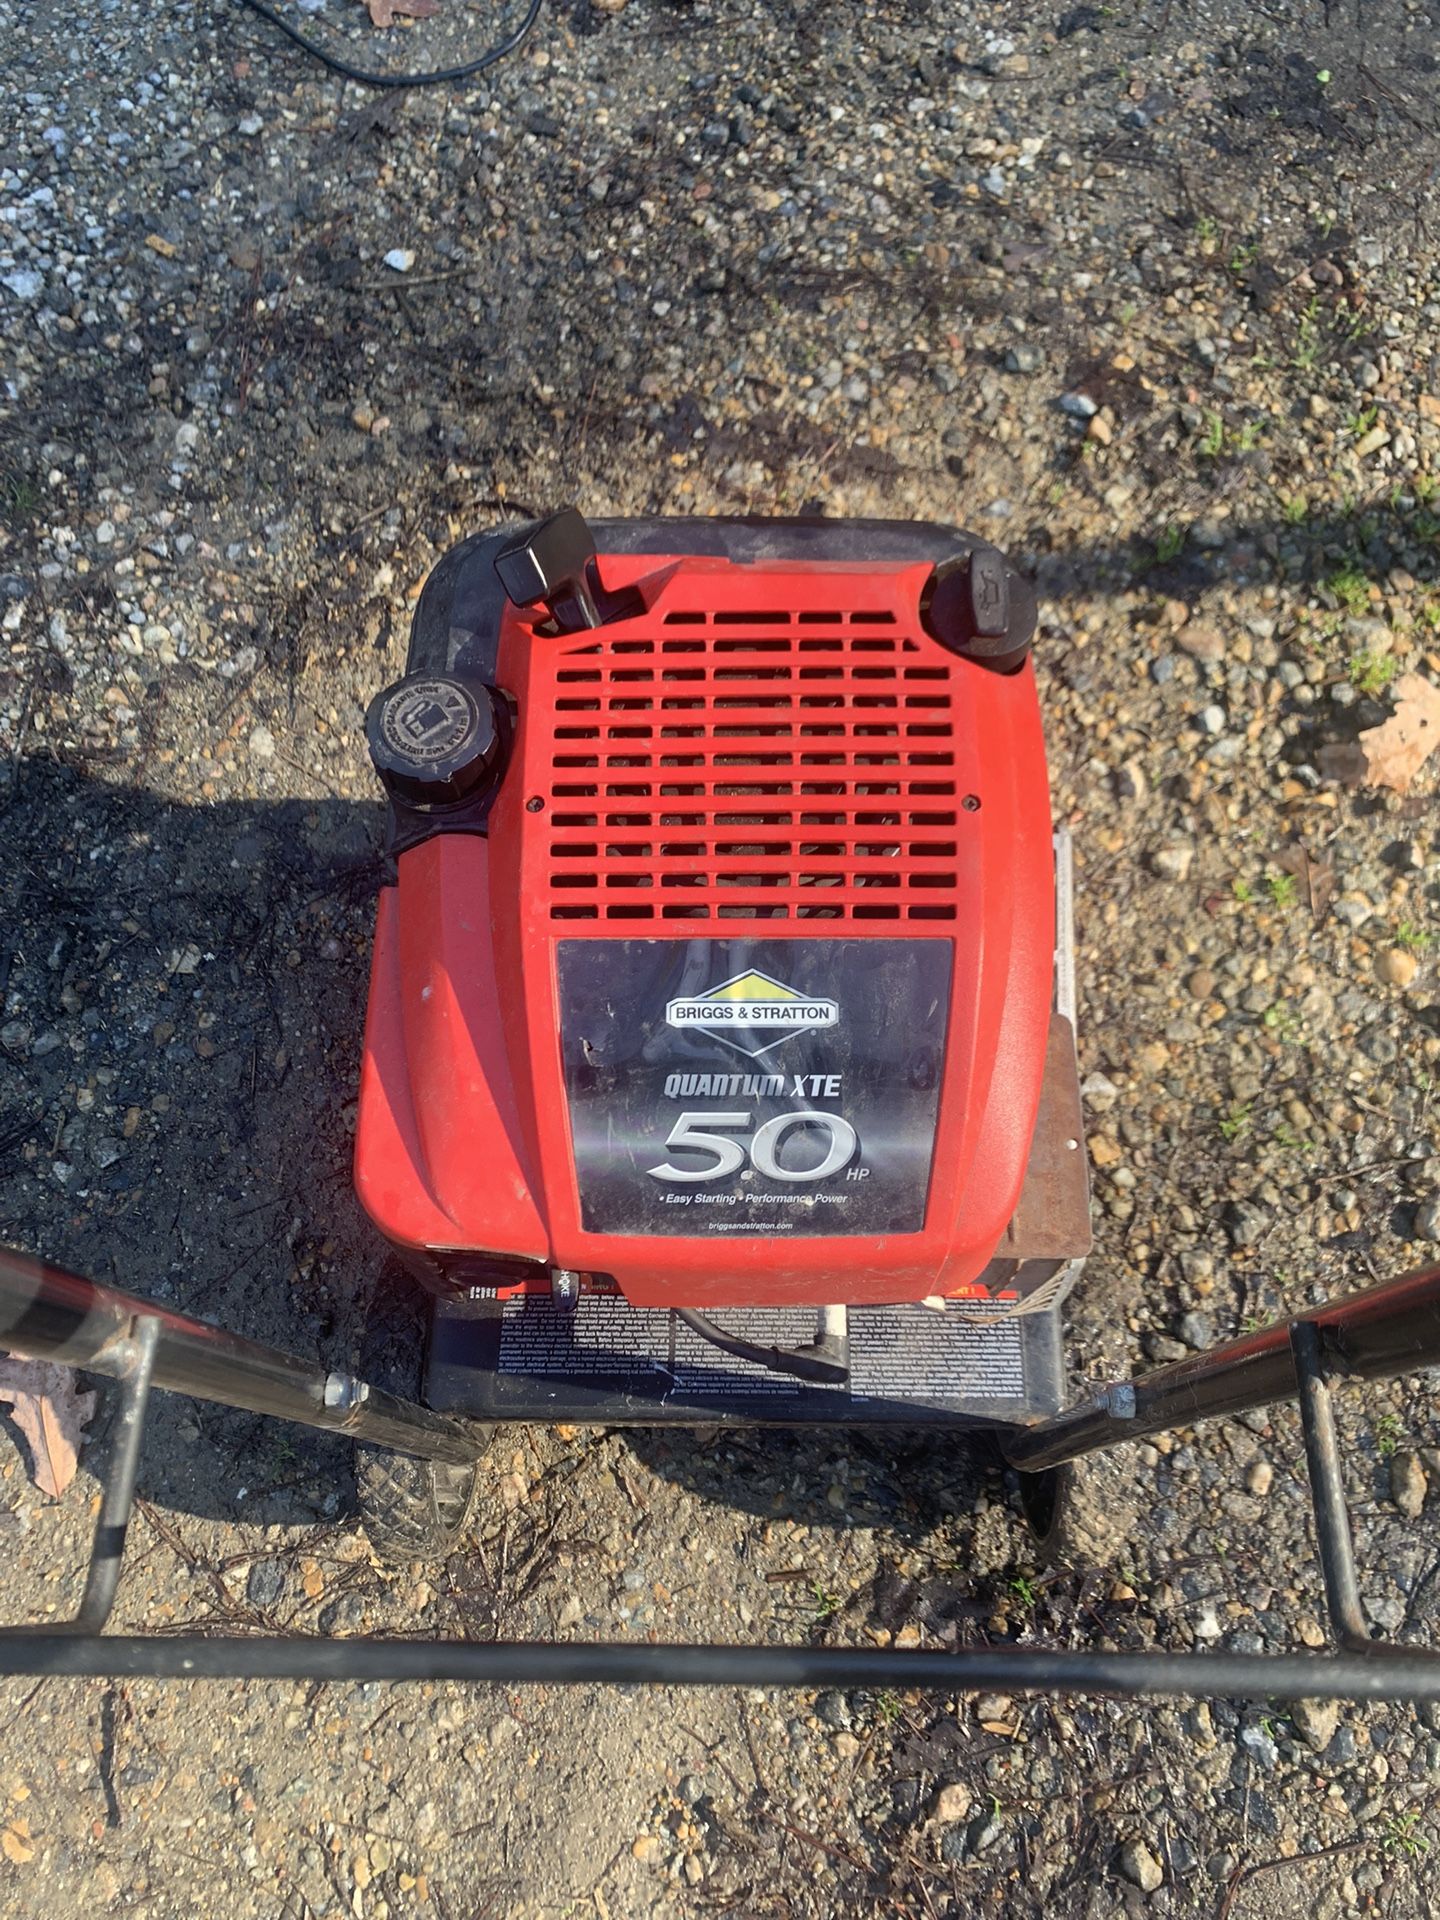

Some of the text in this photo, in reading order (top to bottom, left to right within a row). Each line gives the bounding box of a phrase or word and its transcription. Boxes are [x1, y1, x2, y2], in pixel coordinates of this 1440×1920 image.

[676, 1007, 830, 1019] BRIGGS & STRATTON
[664, 1073, 842, 1098] QUANTUM XTE
[646, 1111, 870, 1182] 5.0 HP
[666, 1193, 849, 1205] Easy Starting Performance Power
[708, 1221, 793, 1231] briggsandstratton.com
[558, 1270, 571, 1298] HOKE
